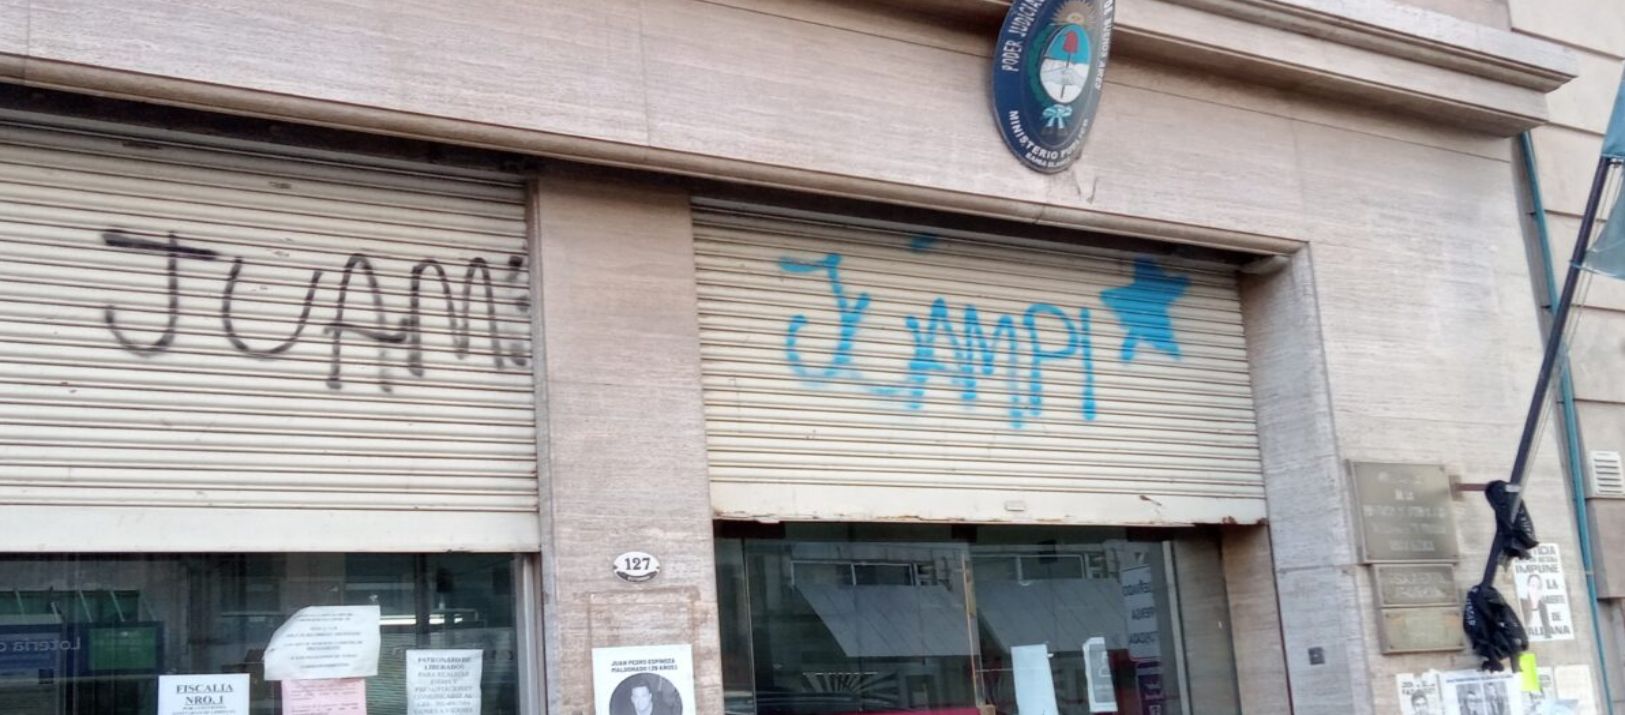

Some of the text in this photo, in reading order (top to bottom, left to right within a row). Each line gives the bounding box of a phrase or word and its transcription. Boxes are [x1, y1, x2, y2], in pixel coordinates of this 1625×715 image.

[1002, 40, 1023, 72] PODER
[1009, 110, 1059, 160] MINISTERIO
[624, 557, 651, 571] 127
[1515, 564, 1560, 574] IMPUNE
[176, 683, 234, 694] FISCALIA
